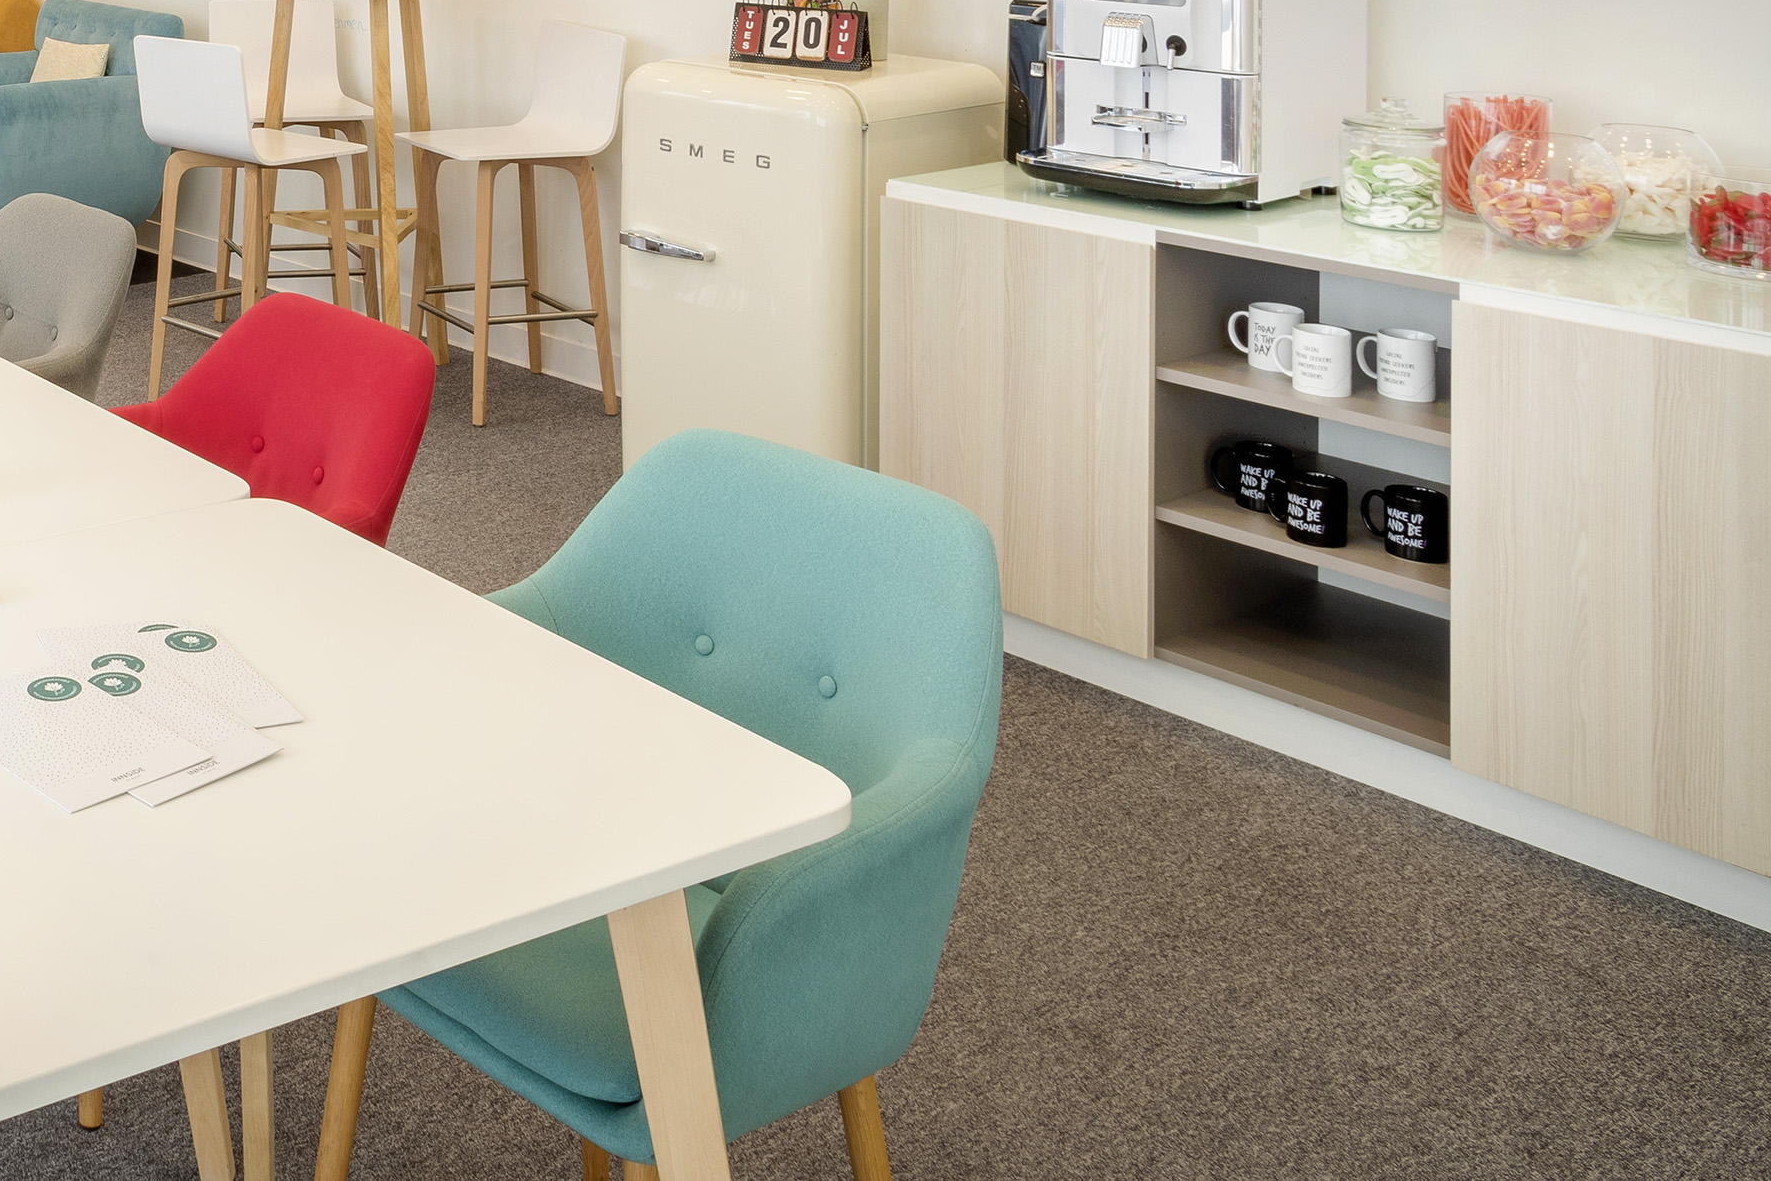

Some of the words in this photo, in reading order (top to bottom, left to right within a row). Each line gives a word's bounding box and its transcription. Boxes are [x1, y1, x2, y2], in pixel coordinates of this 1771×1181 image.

[741, 10, 755, 51] TUES
[769, 16, 822, 49] 20
[836, 19, 850, 55] JUL
[659, 138, 771, 169] SMEG
[1253, 322, 1276, 334] TODAY
[1254, 333, 1259, 343] IS
[1254, 343, 1271, 356] DAY
[1240, 463, 1262, 477] WAKE
[1264, 468, 1276, 479] UP
[1240, 474, 1258, 487] AND
[1287, 491, 1308, 507] WAKE
[1310, 499, 1323, 510] UP
[1287, 503, 1304, 517] AND
[1306, 507, 1321, 522] BE
[1387, 506, 1409, 522] WAKE
[1411, 513, 1424, 525] UP
[1288, 516, 1325, 534] AWESOME!
[1387, 517, 1404, 532] AND
[1407, 522, 1422, 537] BE
[1388, 531, 1427, 549] AWESOME!
